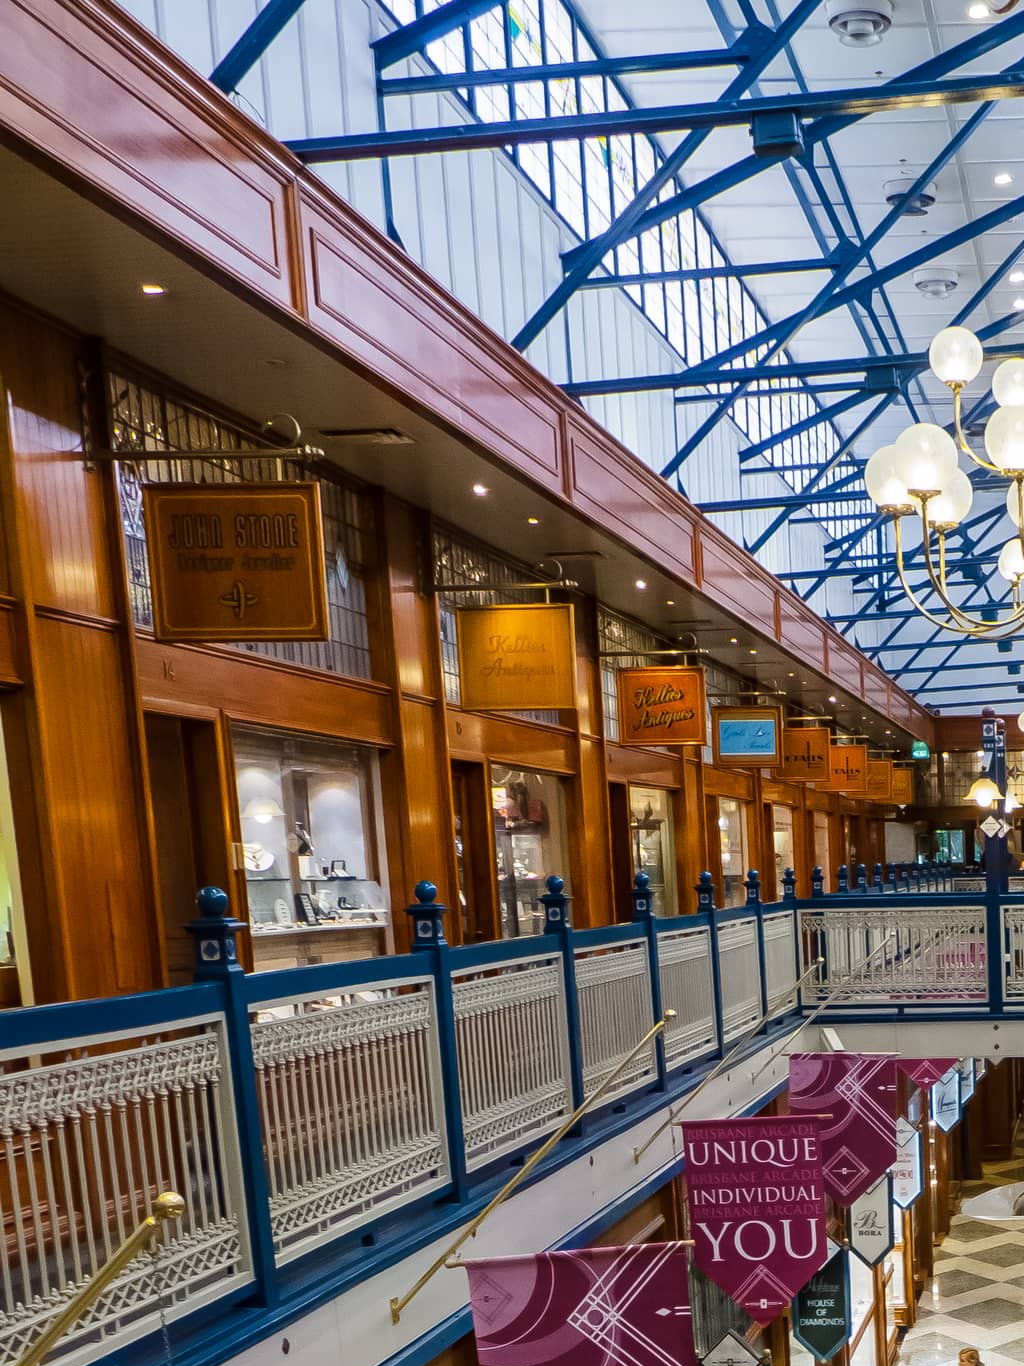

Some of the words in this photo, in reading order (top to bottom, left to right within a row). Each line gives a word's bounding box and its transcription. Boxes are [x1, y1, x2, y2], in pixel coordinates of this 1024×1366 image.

[169, 513, 223, 549] JOHN
[234, 512, 298, 548] STONE
[633, 684, 683, 709] Kellies
[633, 708, 695, 731] Antiques
[688, 1138, 818, 1168] UNIQUE
[693, 1185, 821, 1205] INDIVIDUAL
[696, 1218, 819, 1262] YOU
[807, 1299, 836, 1308] HOUSE
[815, 1308, 828, 1317] OF
[799, 1318, 846, 1327] DIAMONDS
